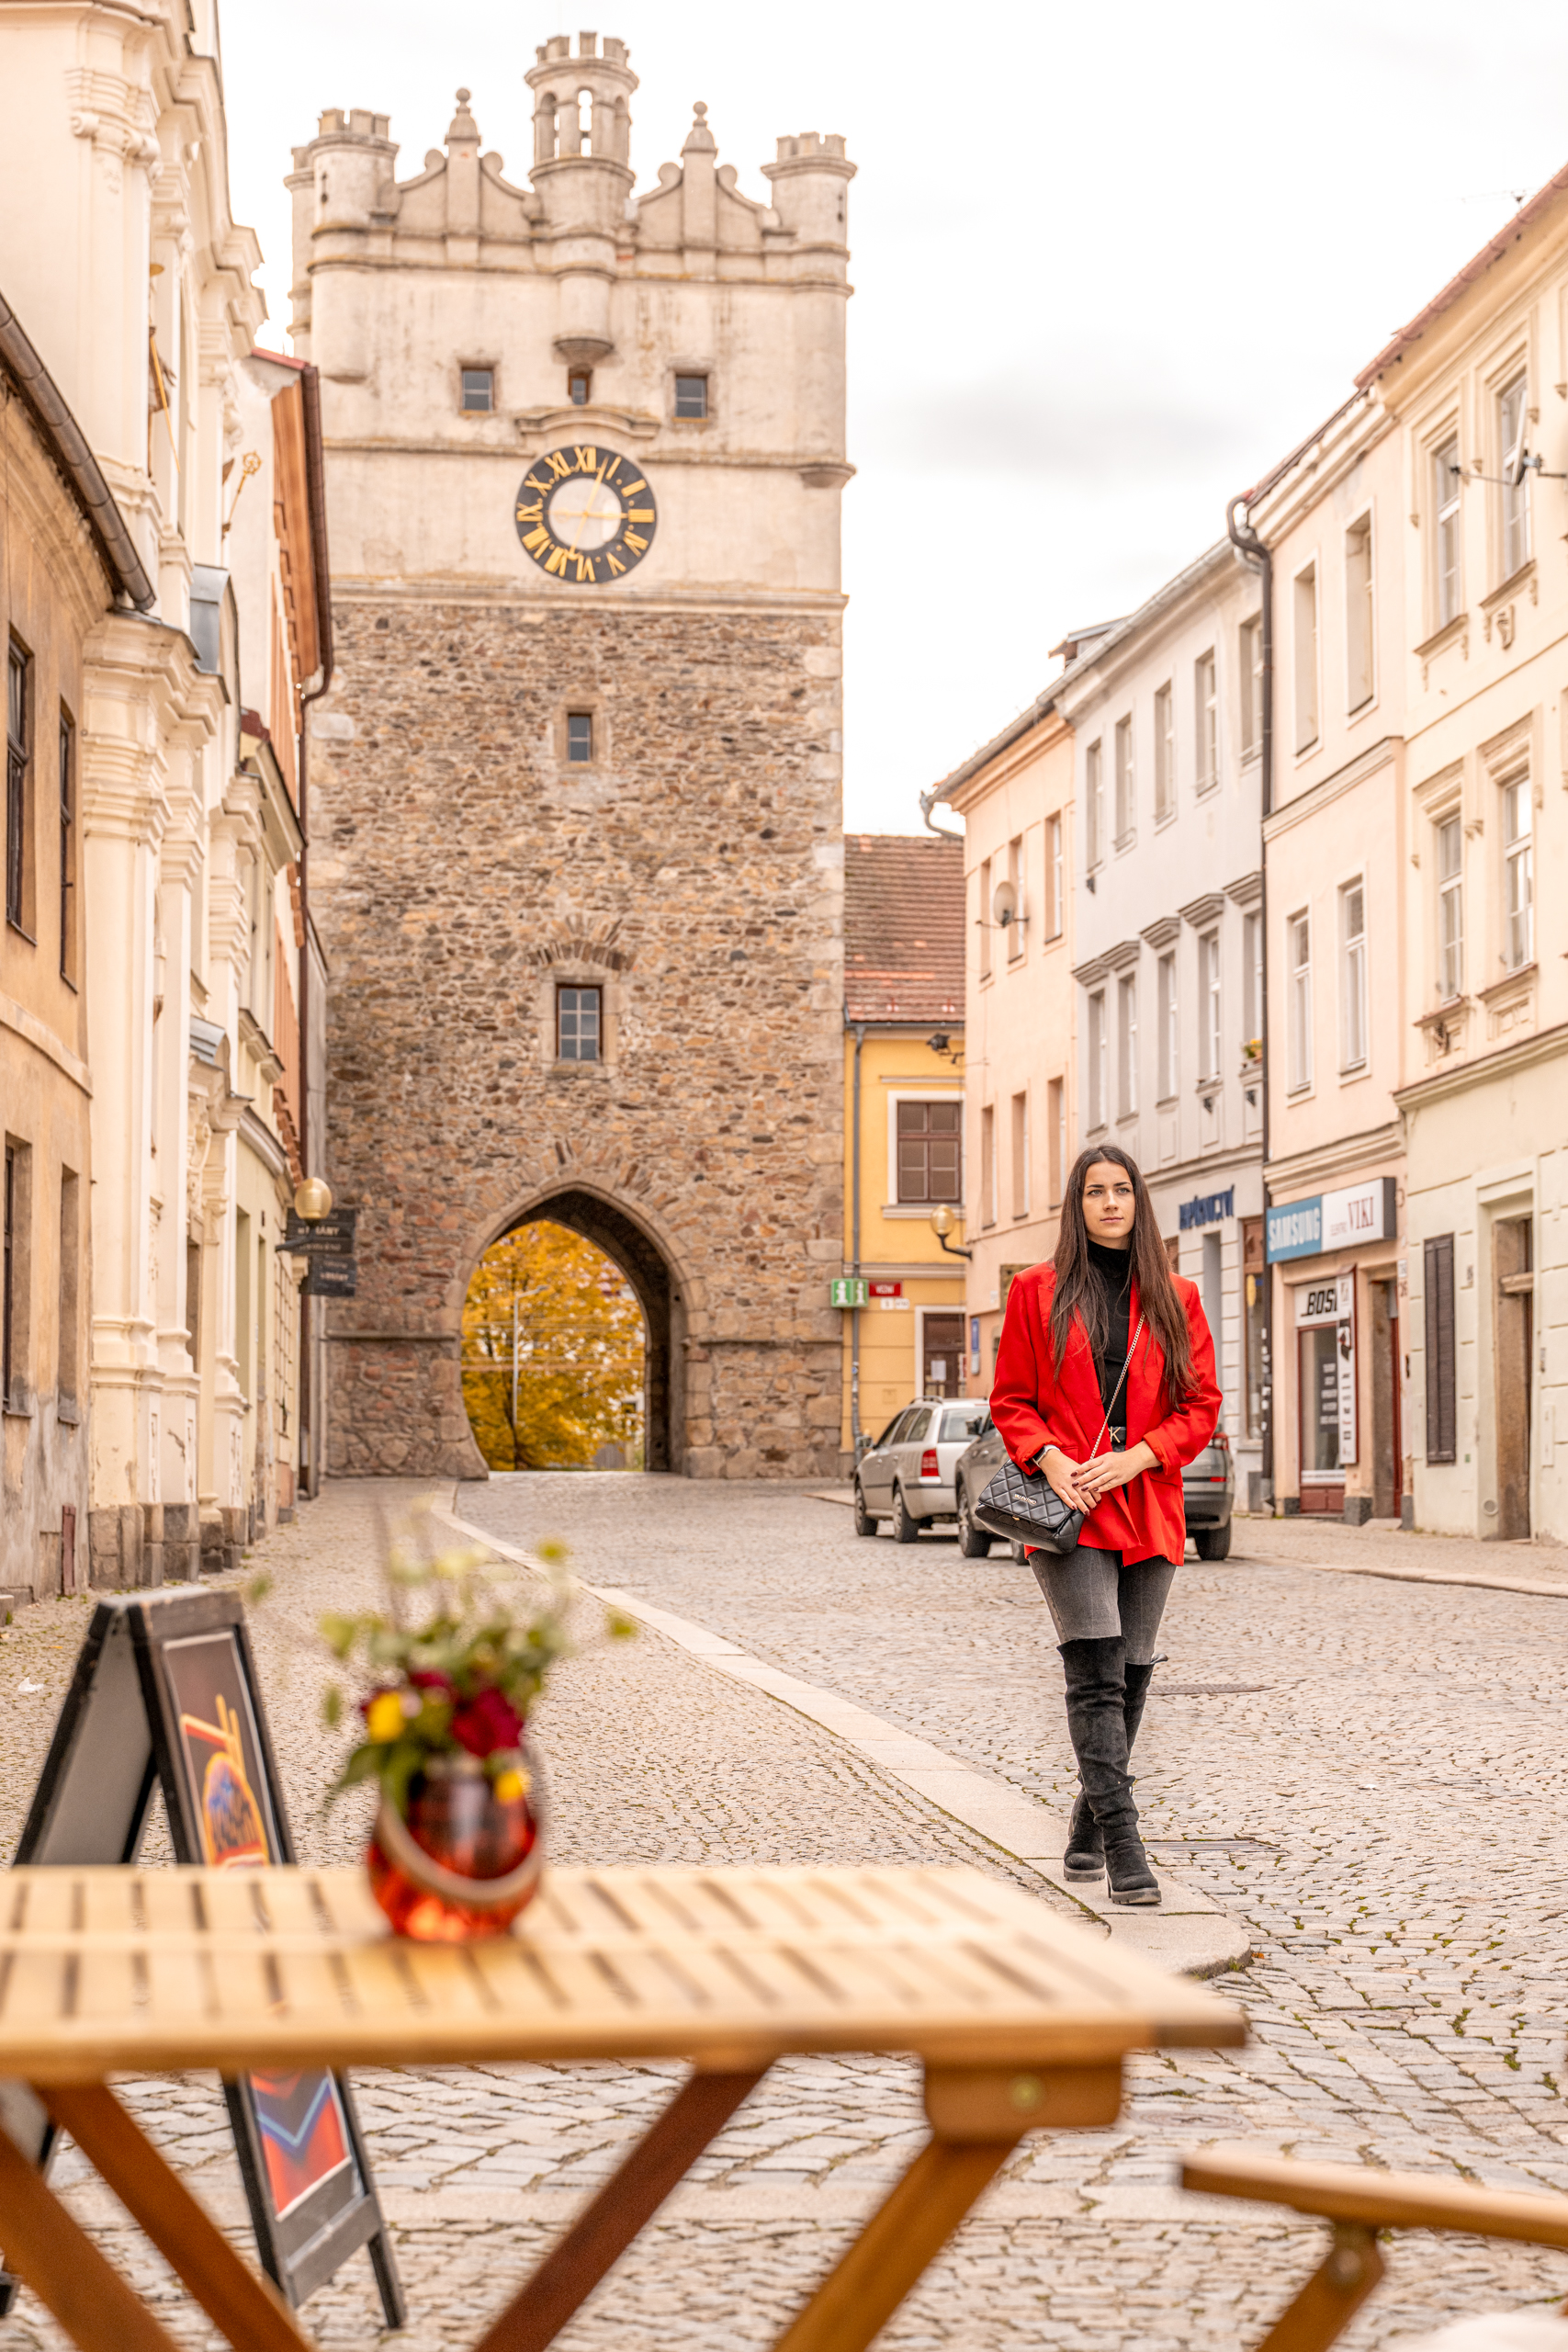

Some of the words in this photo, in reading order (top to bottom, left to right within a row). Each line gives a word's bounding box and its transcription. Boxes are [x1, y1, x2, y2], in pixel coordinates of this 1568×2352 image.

[1269, 1206, 1321, 1252] SAMSUNG
[1348, 1195, 1374, 1230] VIKI
[1014, 1493, 1037, 1505] VALENTINO
